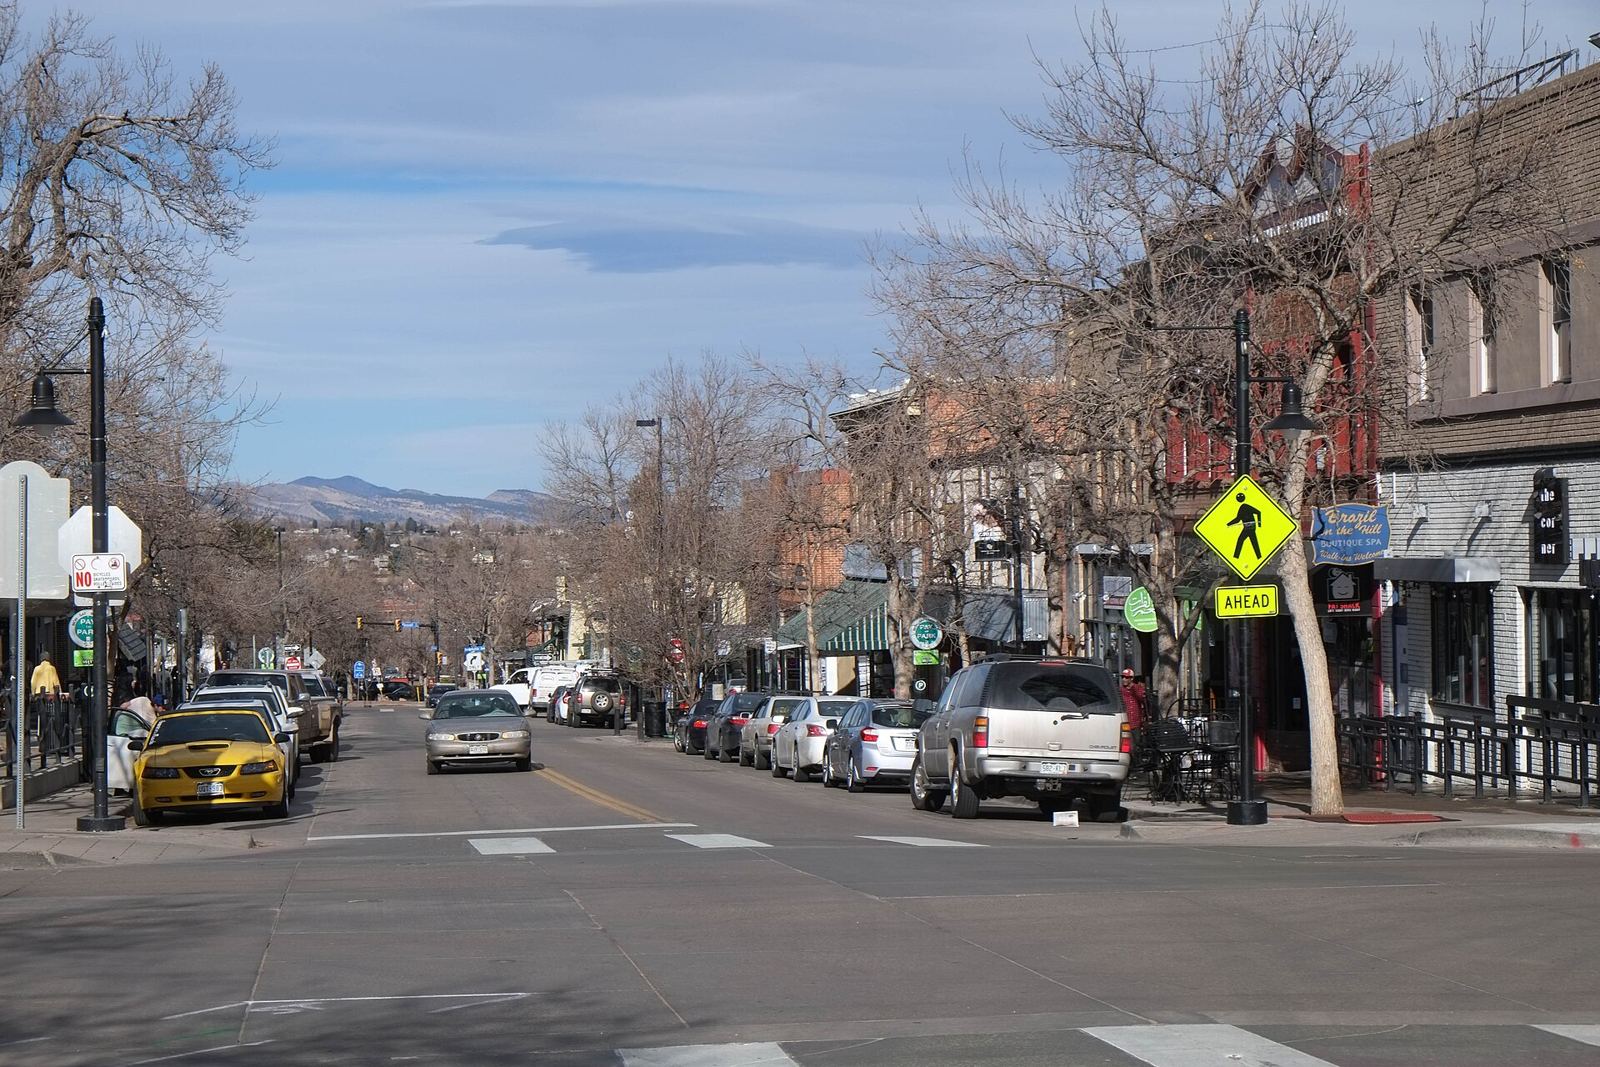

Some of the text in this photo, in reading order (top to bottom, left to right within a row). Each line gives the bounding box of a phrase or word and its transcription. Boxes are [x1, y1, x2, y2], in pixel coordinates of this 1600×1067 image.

[1540, 488, 1555, 501] the
[1325, 510, 1377, 528] Brazil
[1540, 517, 1556, 528] cor
[1336, 526, 1354, 535] the
[1358, 524, 1383, 535] Hill
[1321, 539, 1363, 548] BOUTIQUE
[1541, 544, 1556, 554] ner
[76, 571, 92, 588] NO
[1224, 594, 1270, 609] AHEAD
